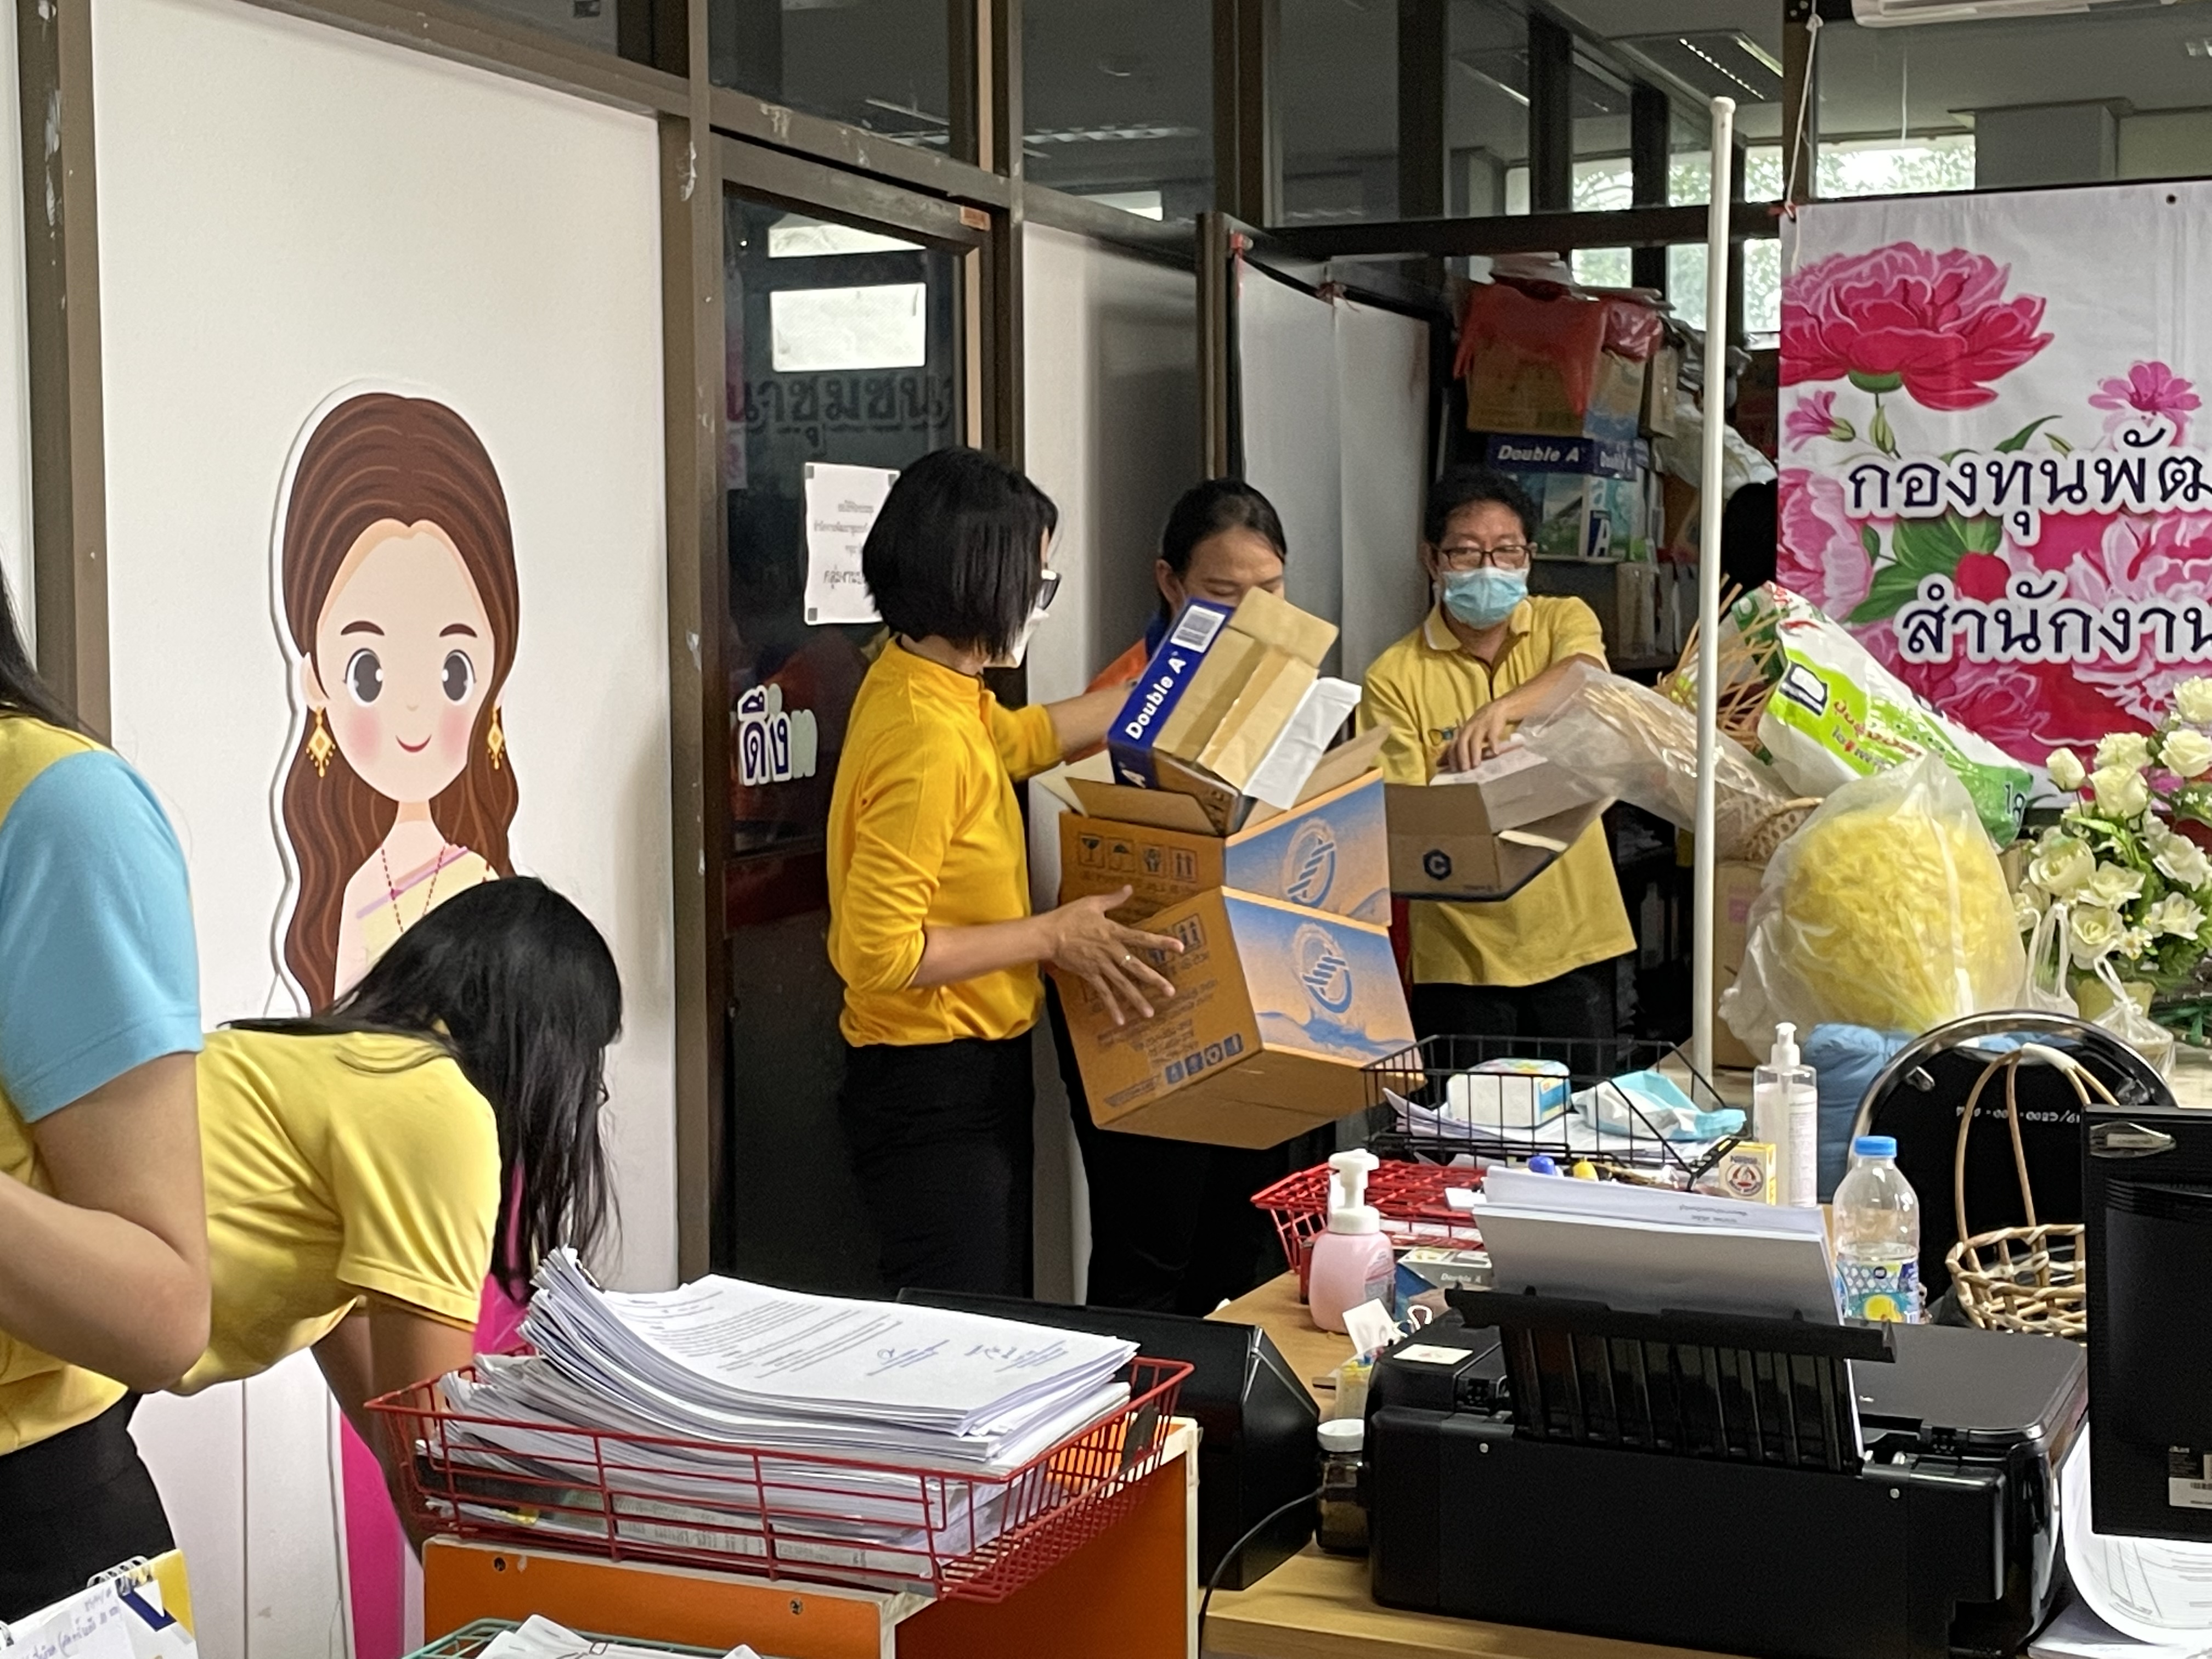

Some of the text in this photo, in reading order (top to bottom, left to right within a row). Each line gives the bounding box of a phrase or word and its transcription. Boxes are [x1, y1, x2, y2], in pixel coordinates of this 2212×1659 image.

[1498, 444, 1579, 462] Double A
[740, 687, 790, 782] ดึง
[1125, 658, 1187, 740] Double A
